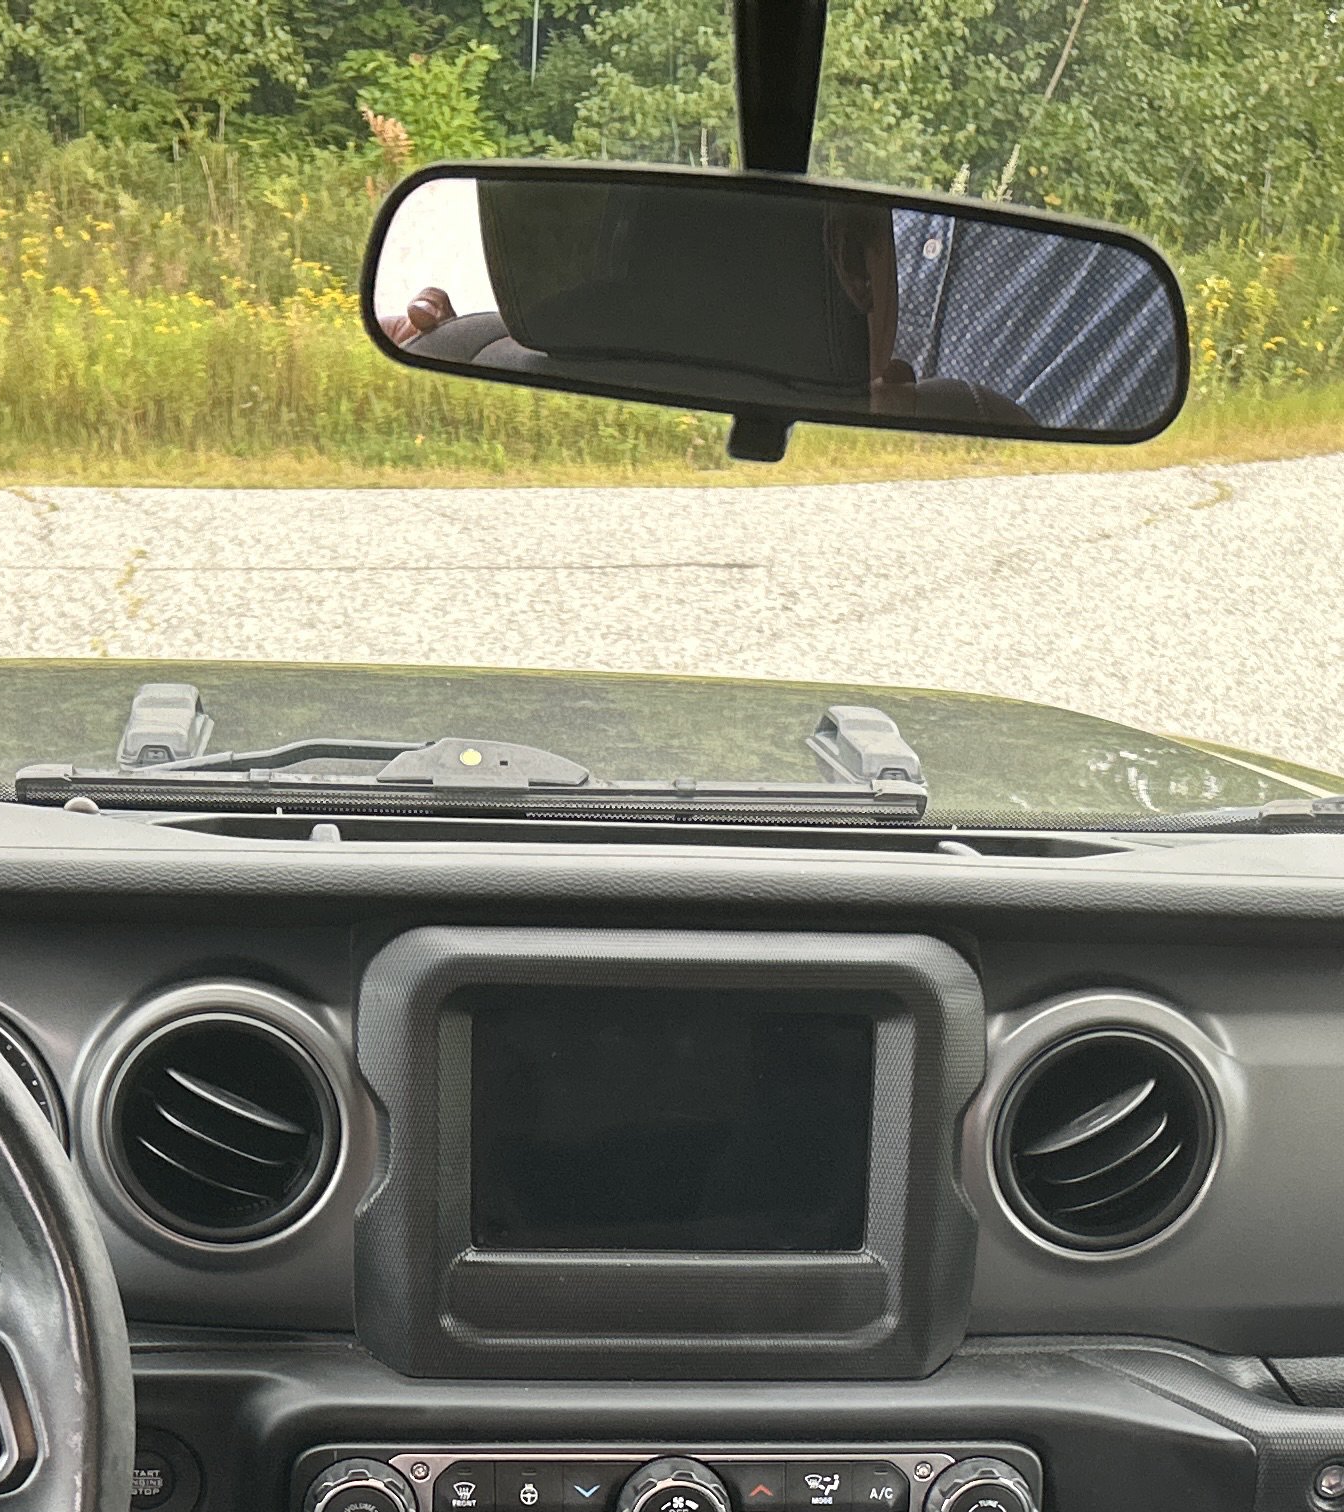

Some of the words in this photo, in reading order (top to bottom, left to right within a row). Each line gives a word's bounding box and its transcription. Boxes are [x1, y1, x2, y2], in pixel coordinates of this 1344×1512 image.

[132, 1479, 163, 1487] NGINE
[869, 1487, 894, 1501] A/C
[452, 1499, 477, 1507] FRONT
[811, 1496, 833, 1505] MODE
[344, 1503, 376, 1512] VOLUME
